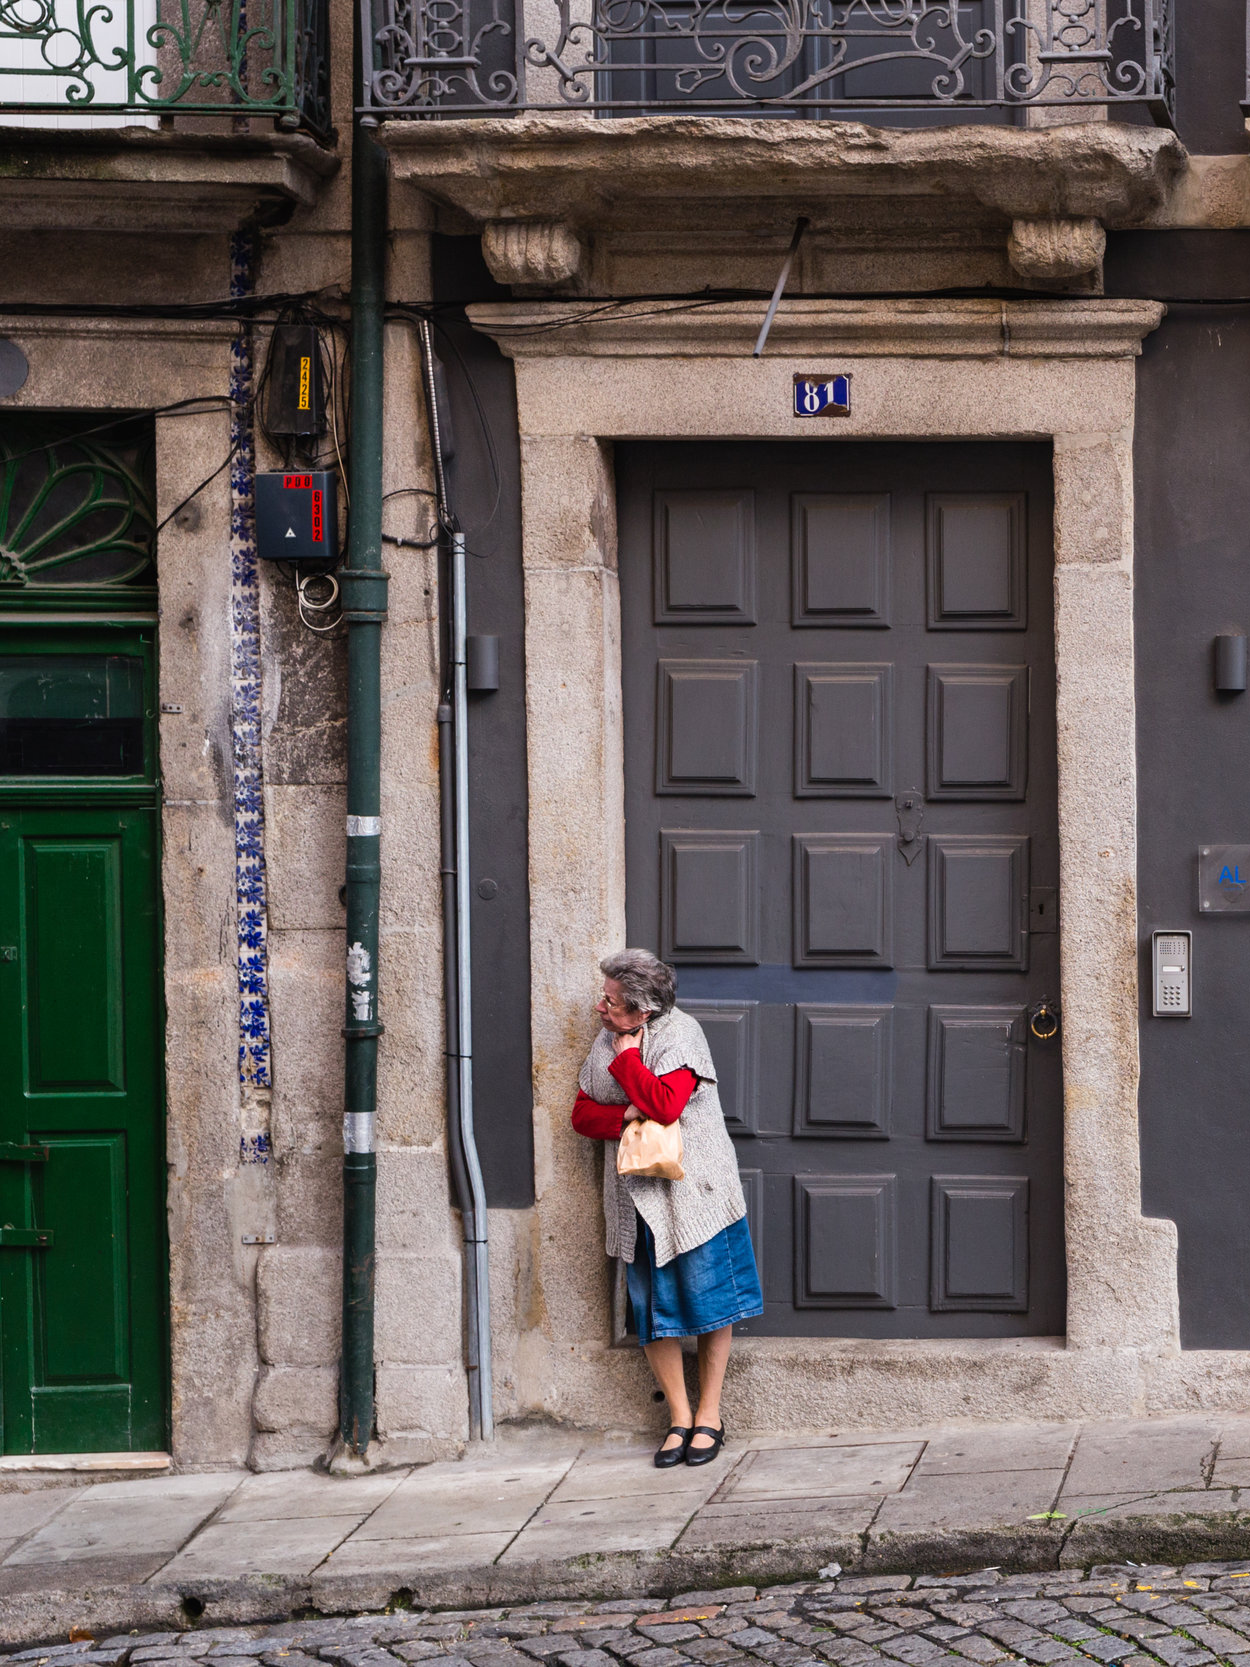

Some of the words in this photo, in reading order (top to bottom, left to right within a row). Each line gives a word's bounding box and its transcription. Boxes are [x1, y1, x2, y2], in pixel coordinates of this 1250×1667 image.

[300, 358, 309, 408] 2425
[804, 381, 834, 412] 81
[1218, 865, 1247, 884] AL
